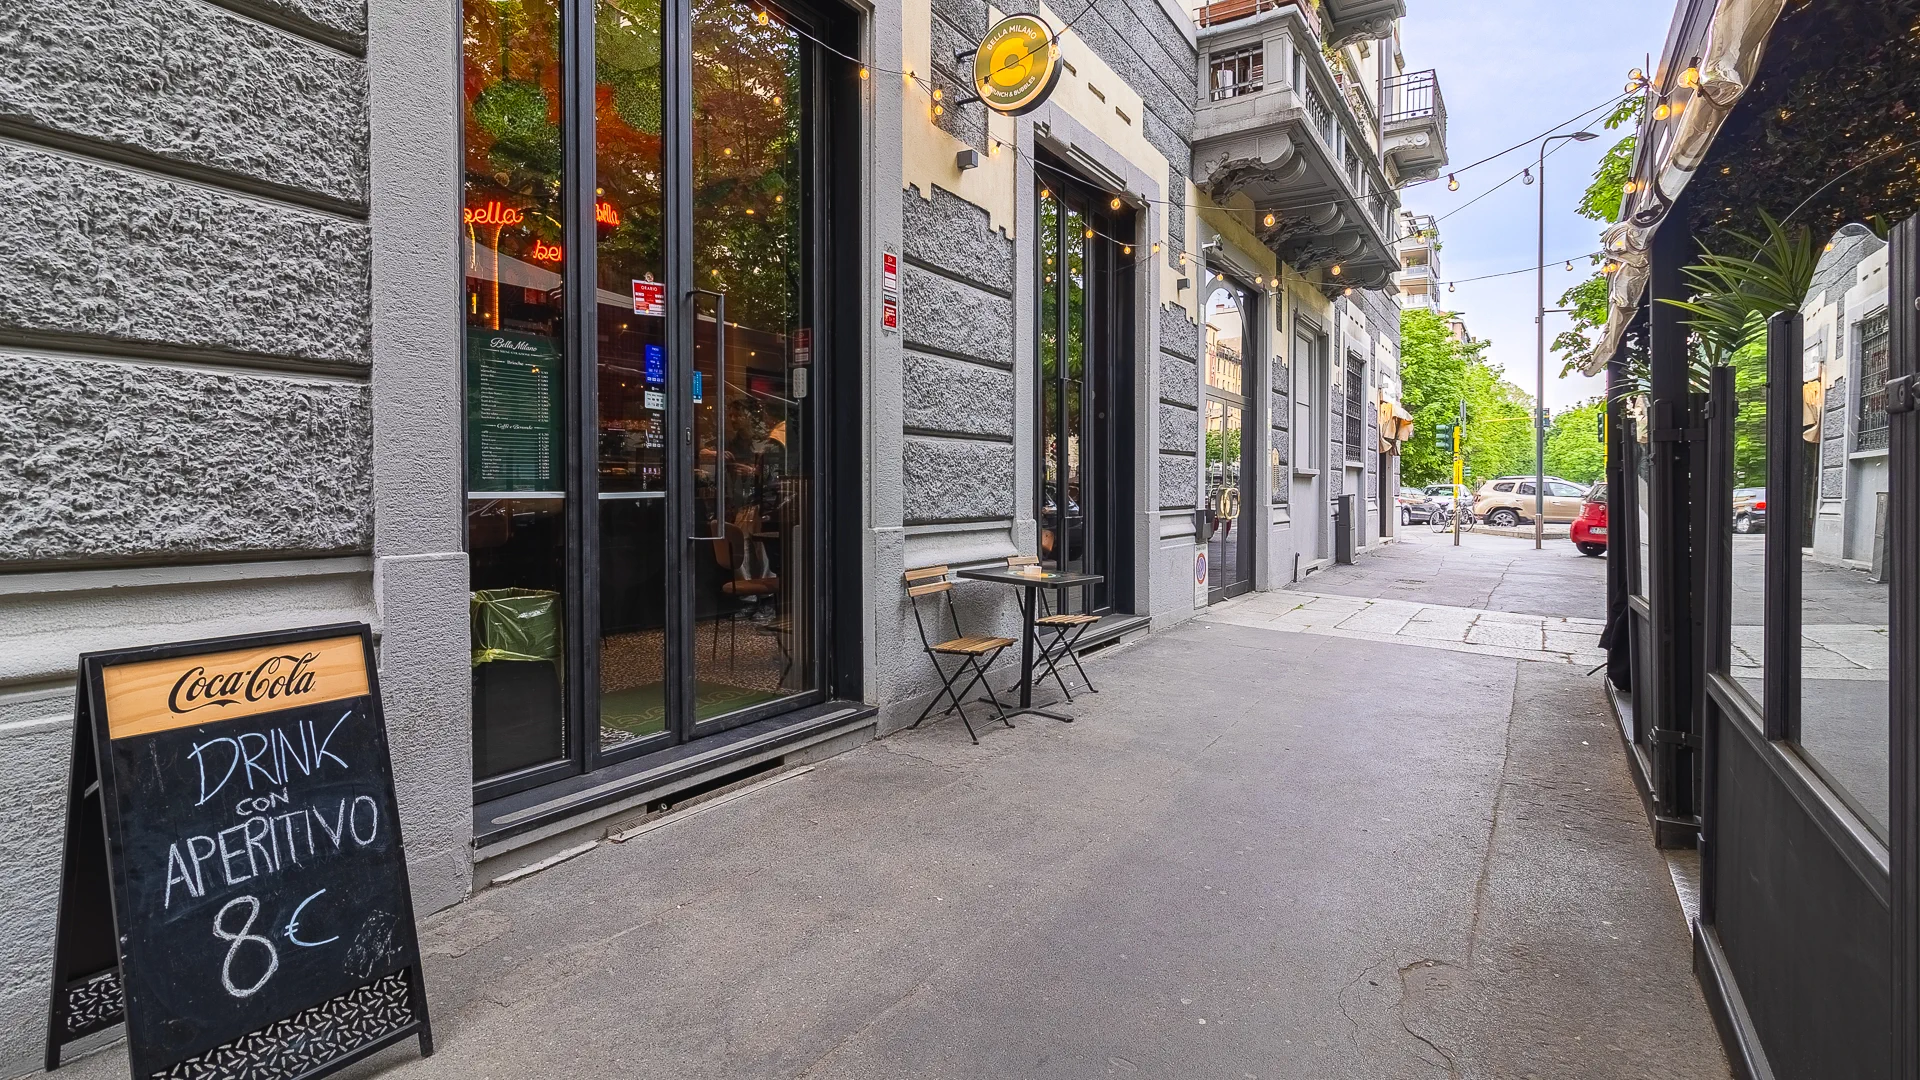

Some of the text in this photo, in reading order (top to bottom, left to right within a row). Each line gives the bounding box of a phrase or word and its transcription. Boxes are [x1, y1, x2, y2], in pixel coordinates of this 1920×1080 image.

[987, 24, 1037, 51] BELLA MILANO
[990, 86, 1009, 98] RUNCH
[1013, 76, 1036, 95] BUBBLES
[490, 337, 537, 352] Bella Milano
[167, 650, 322, 714] Coca-Cola
[187, 709, 354, 807] DRINK
[235, 787, 290, 816] CON
[163, 794, 379, 910] APERITIVO
[212, 887, 341, 998] 8 €
